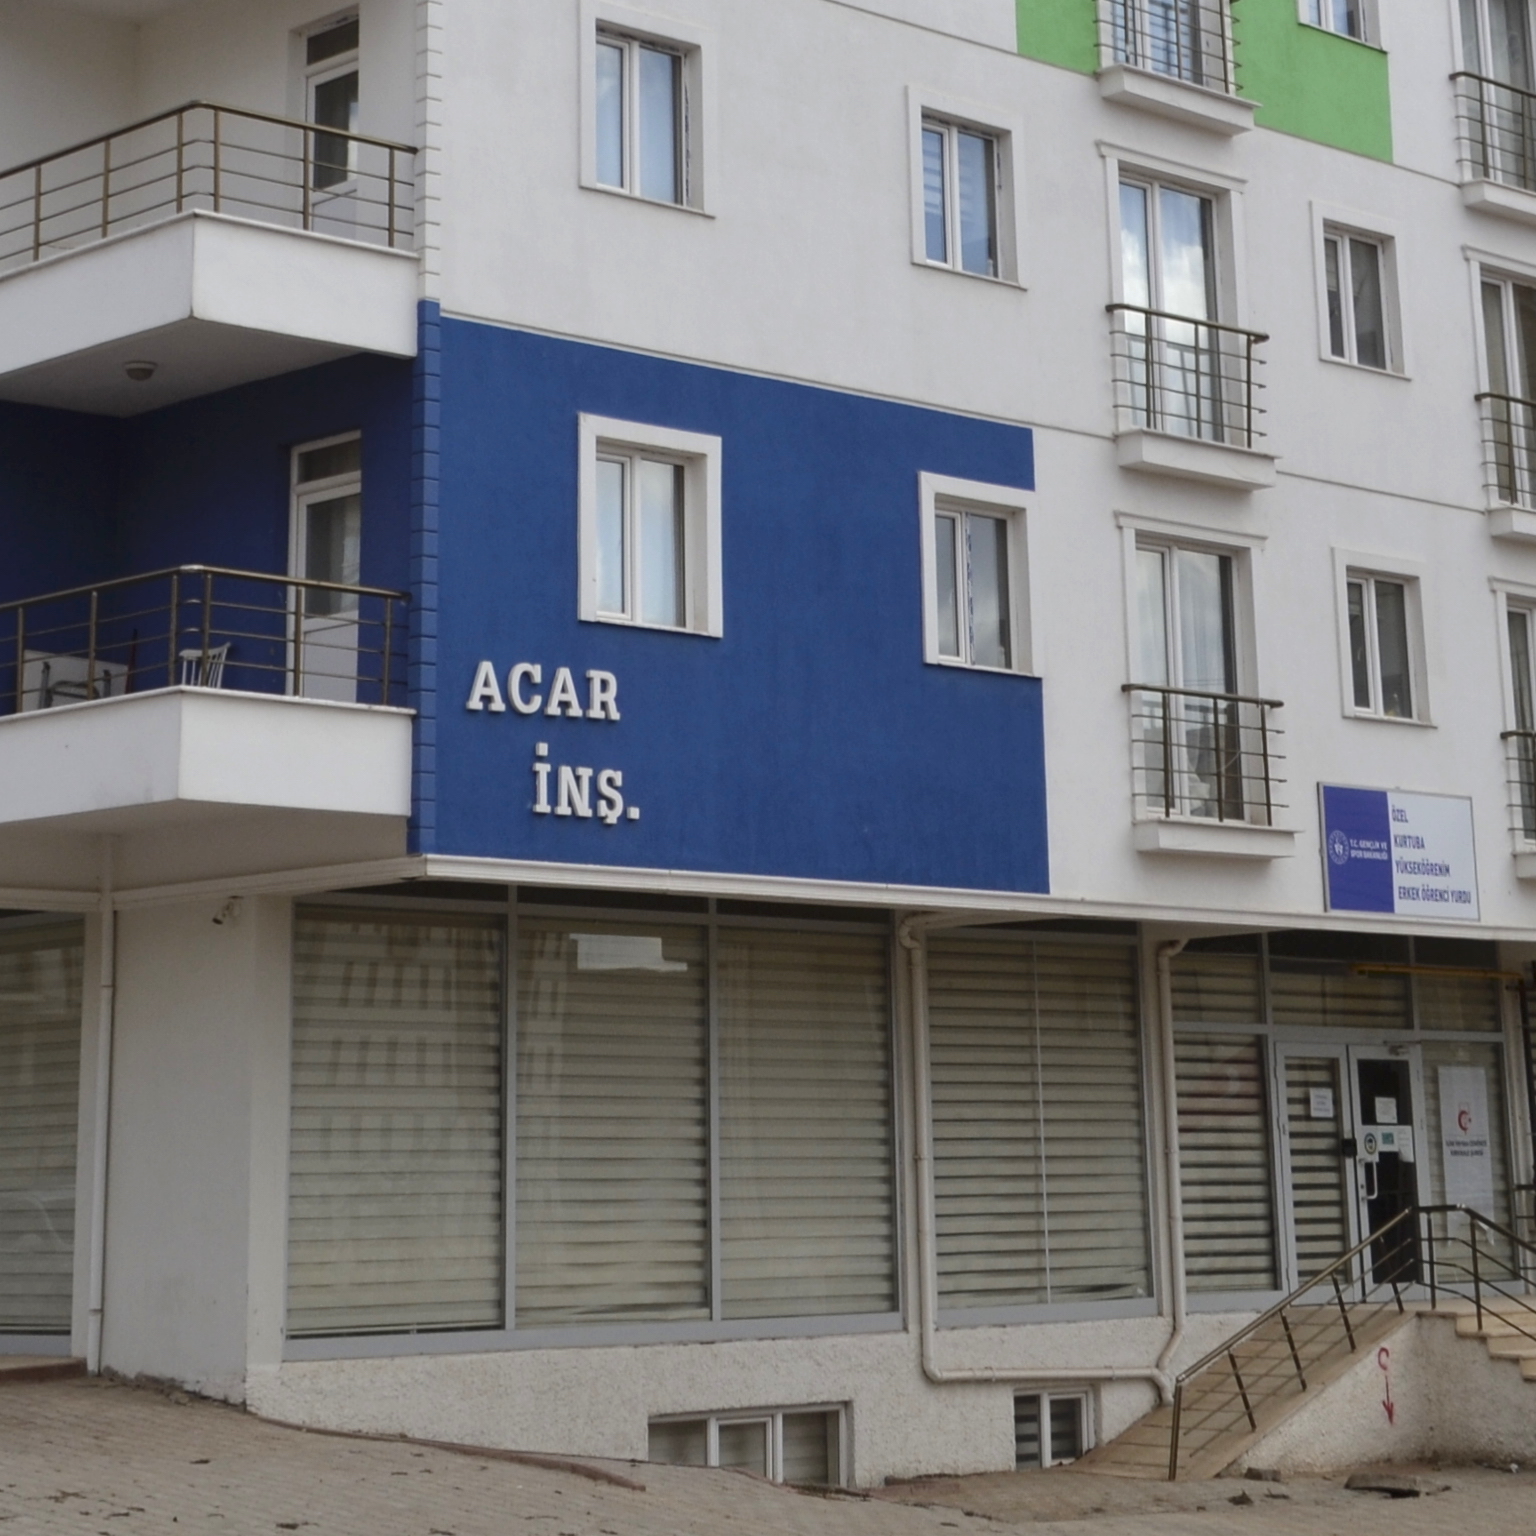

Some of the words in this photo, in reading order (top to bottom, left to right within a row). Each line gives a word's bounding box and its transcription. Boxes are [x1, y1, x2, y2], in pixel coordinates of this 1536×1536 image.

[466, 660, 621, 721] ACAR
[532, 742, 641, 824] İNŞ.
[1391, 804, 1409, 823] ÖZEL
[1394, 834, 1426, 850] KURTUBA
[1398, 886, 1421, 901] ERKEK
[1450, 891, 1472, 904] YURDU
